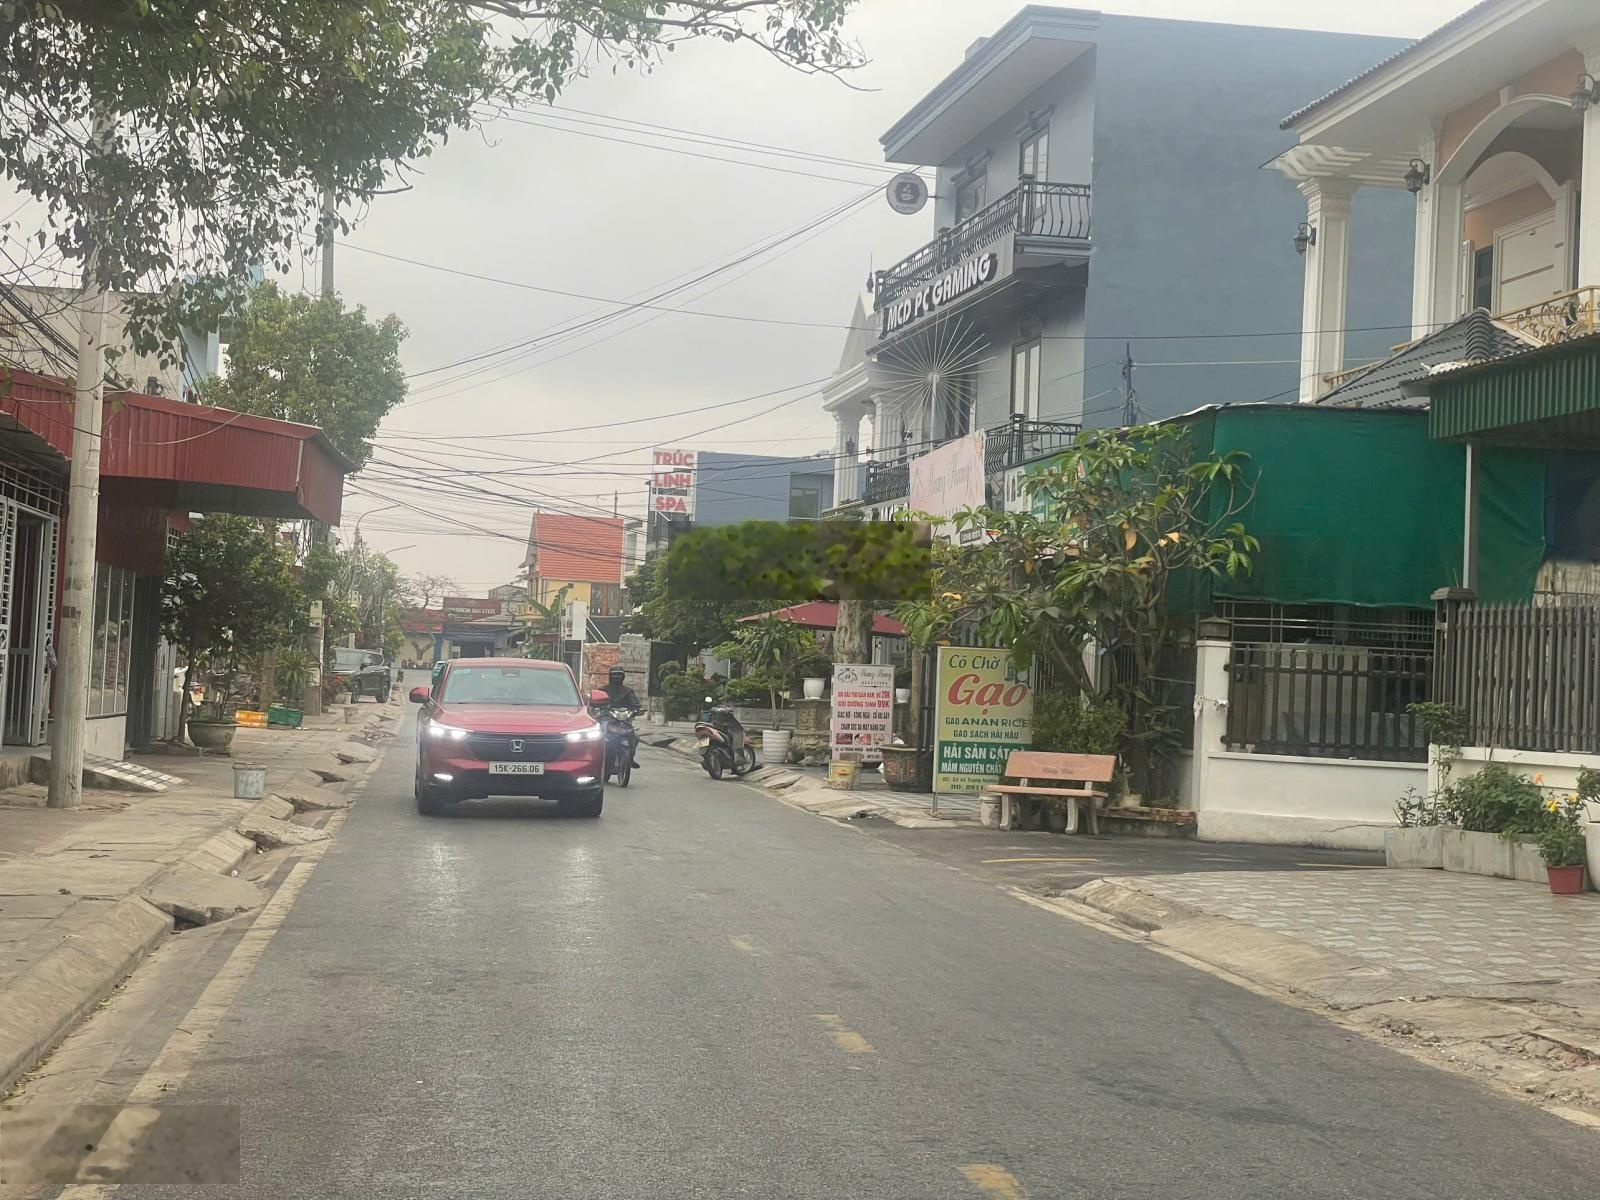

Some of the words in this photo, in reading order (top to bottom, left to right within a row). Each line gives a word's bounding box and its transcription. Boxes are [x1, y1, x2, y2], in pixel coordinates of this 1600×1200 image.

[887, 298, 912, 331] MCD
[914, 286, 930, 317] PC
[932, 252, 991, 305] GAMING
[653, 449, 694, 466] TRÚC
[655, 473, 691, 487] LINH
[655, 496, 687, 512] SPA
[949, 654, 967, 668] Cô
[972, 655, 1000, 669] Chờ
[947, 672, 1028, 715] Gạo
[877, 700, 889, 708] 99K
[961, 718, 999, 727] ANAN
[964, 744, 986, 759] SẢN
[494, 764, 540, 773] 15K-266.06
